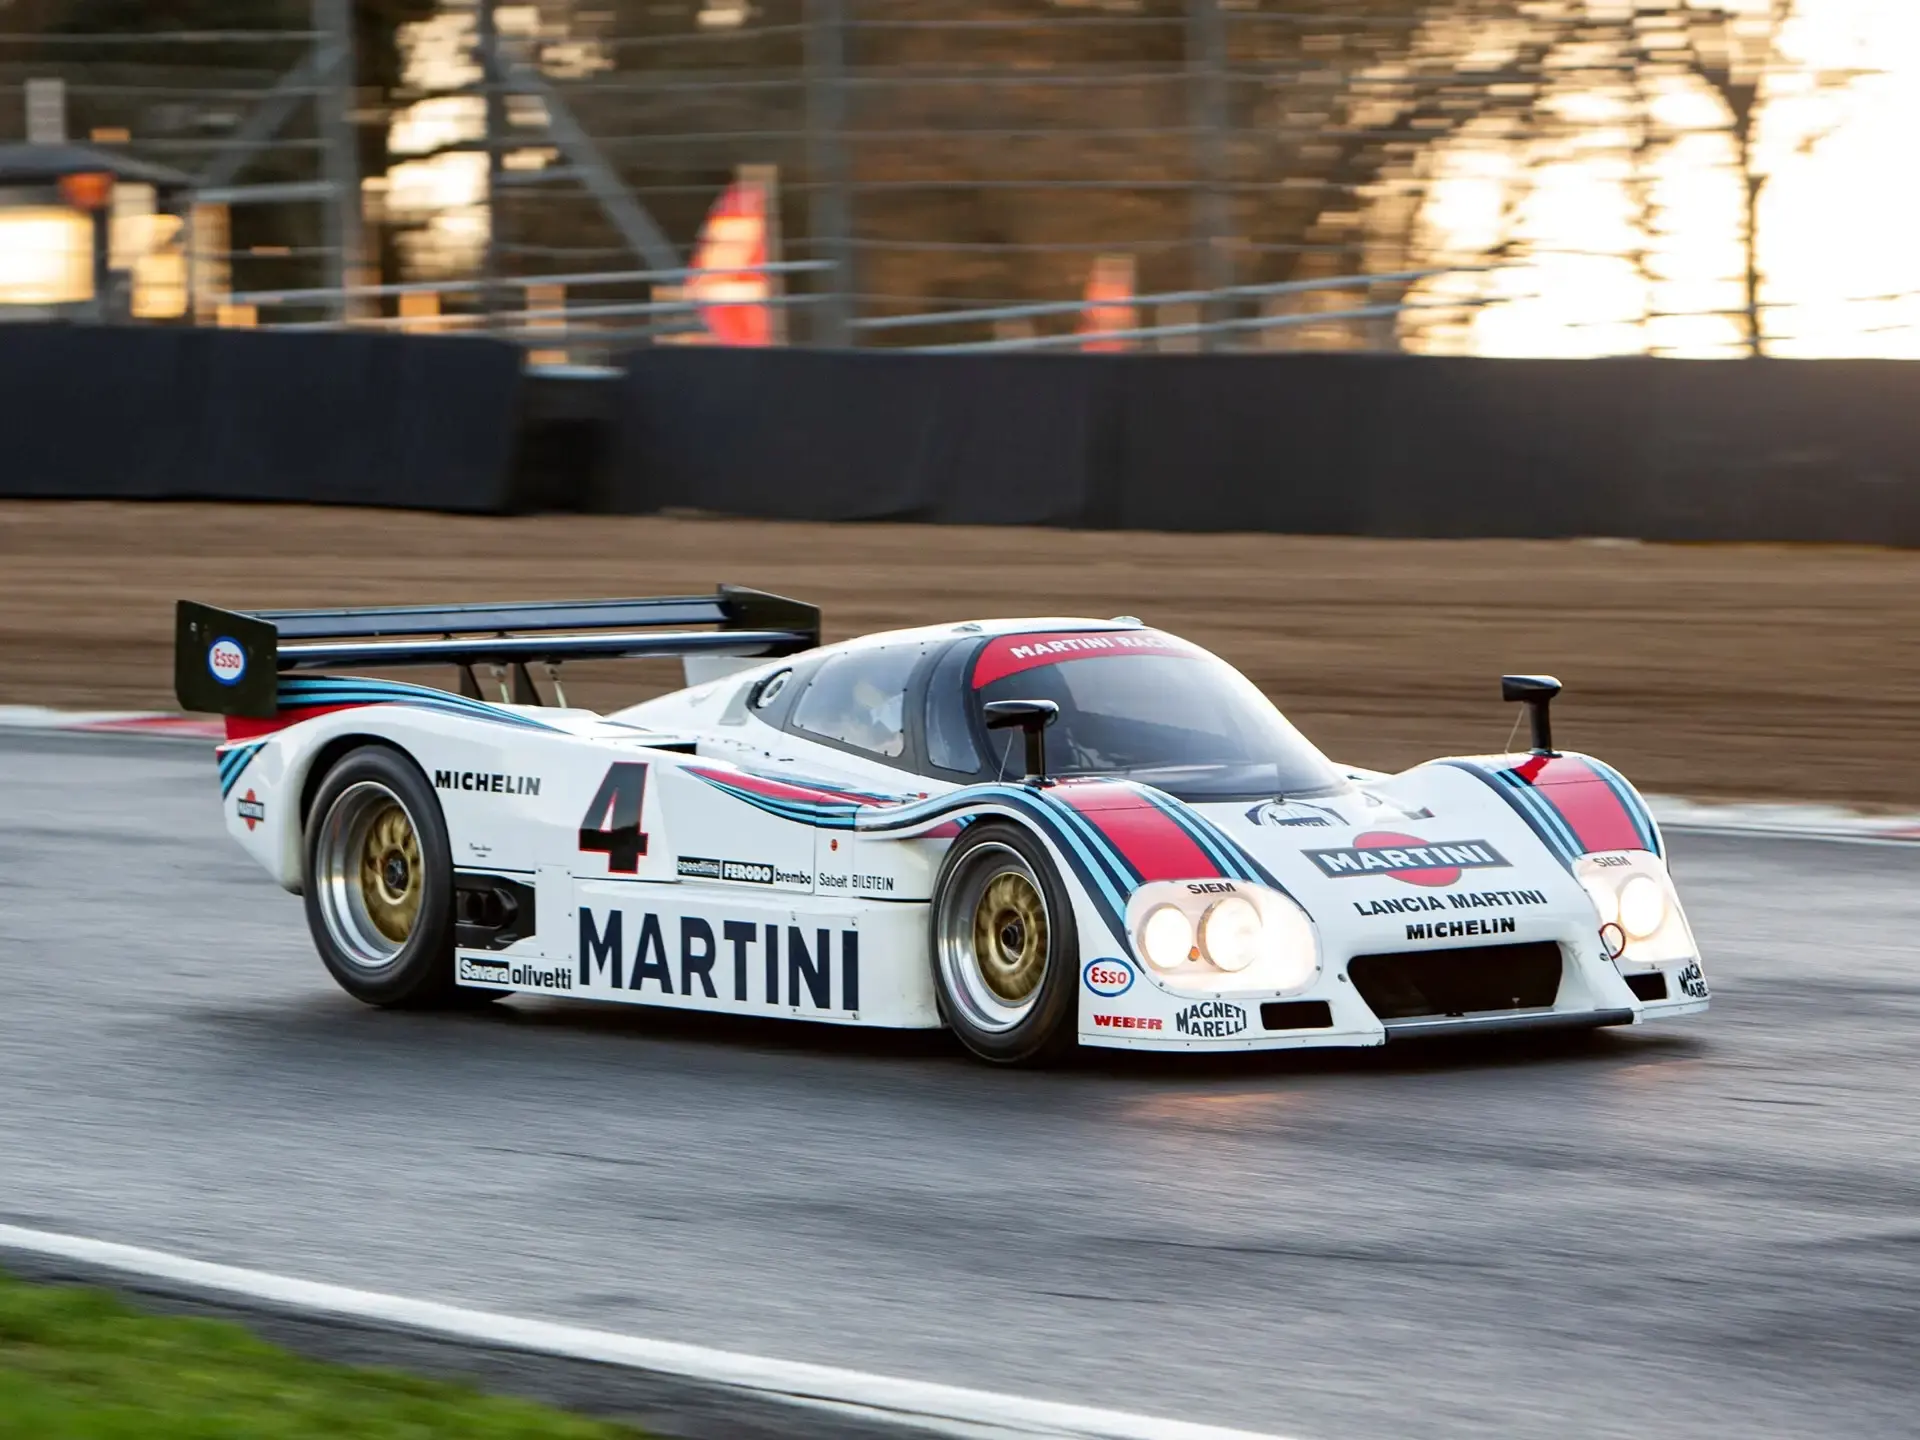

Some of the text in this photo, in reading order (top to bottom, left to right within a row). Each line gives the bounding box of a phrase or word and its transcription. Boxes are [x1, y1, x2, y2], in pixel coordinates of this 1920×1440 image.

[1010, 637, 1112, 659] MARTINI
[435, 769, 541, 796] MICHELIN
[578, 761, 649, 874] 4
[1319, 845, 1495, 873] MARTINI
[1593, 855, 1632, 868] SIEM
[724, 863, 771, 882] FERODO
[775, 868, 812, 885] brembo
[819, 872, 848, 888] Sabelt
[852, 874, 894, 891] BILSTEIN
[1187, 882, 1236, 894] SIEM
[1353, 890, 1548, 916] LANCIA MARTINI
[1405, 917, 1516, 940] MICHELIN
[578, 906, 859, 1011] MARTINI
[461, 959, 509, 982] Savara
[512, 964, 571, 989] olivetti
[1093, 1014, 1163, 1030] WEBER
[1176, 1002, 1247, 1027] MAGNETI
[1176, 1013, 1247, 1037] MARELLI
